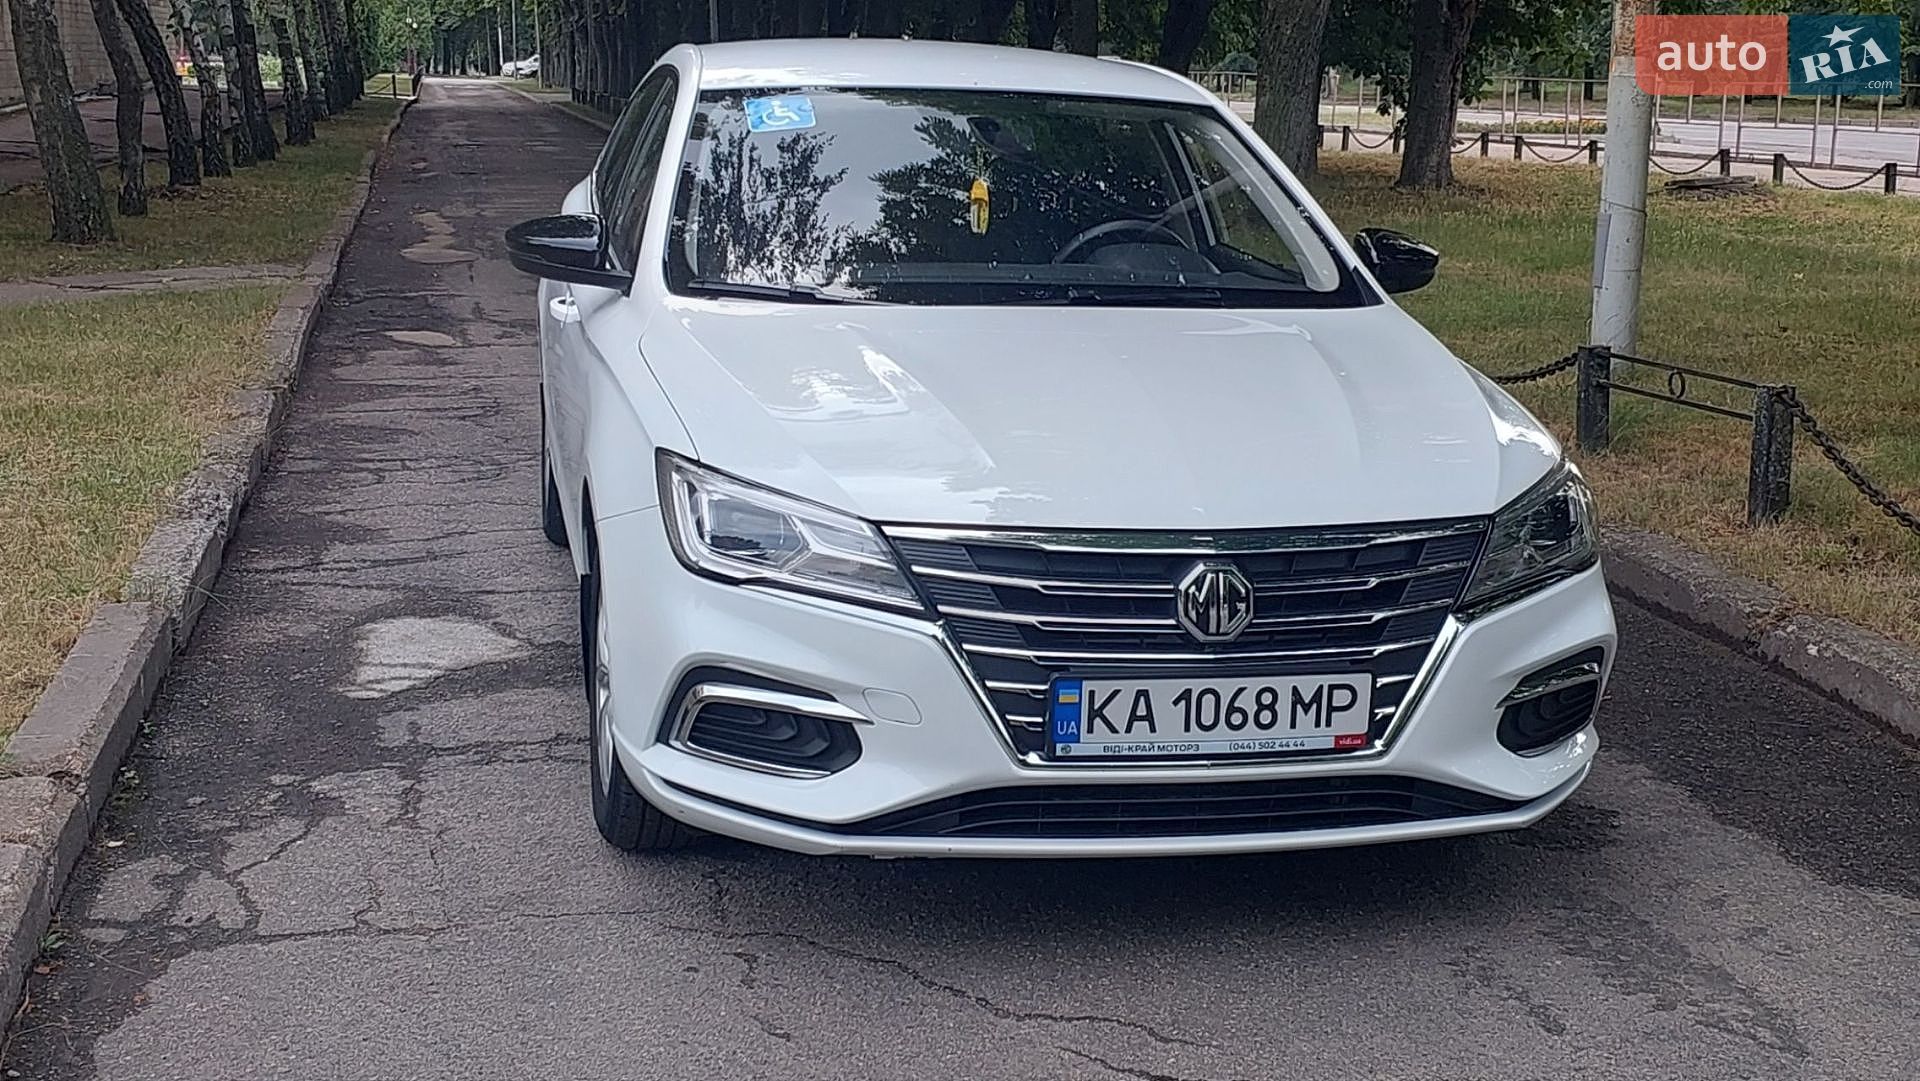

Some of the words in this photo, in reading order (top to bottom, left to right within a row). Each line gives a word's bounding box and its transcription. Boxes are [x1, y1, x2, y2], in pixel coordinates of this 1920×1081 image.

[1187, 572, 1246, 634] MG
[1086, 688, 1157, 734] KA
[1171, 686, 1280, 733] 1068
[1288, 684, 1359, 730] MP
[1057, 721, 1078, 735] UA
[1157, 743, 1200, 753] МОТОРЗ
[1229, 742, 1256, 751] (044)
[1258, 741, 1276, 750] 502
[1278, 740, 1291, 749] 44
[1292, 739, 1306, 748] 44
